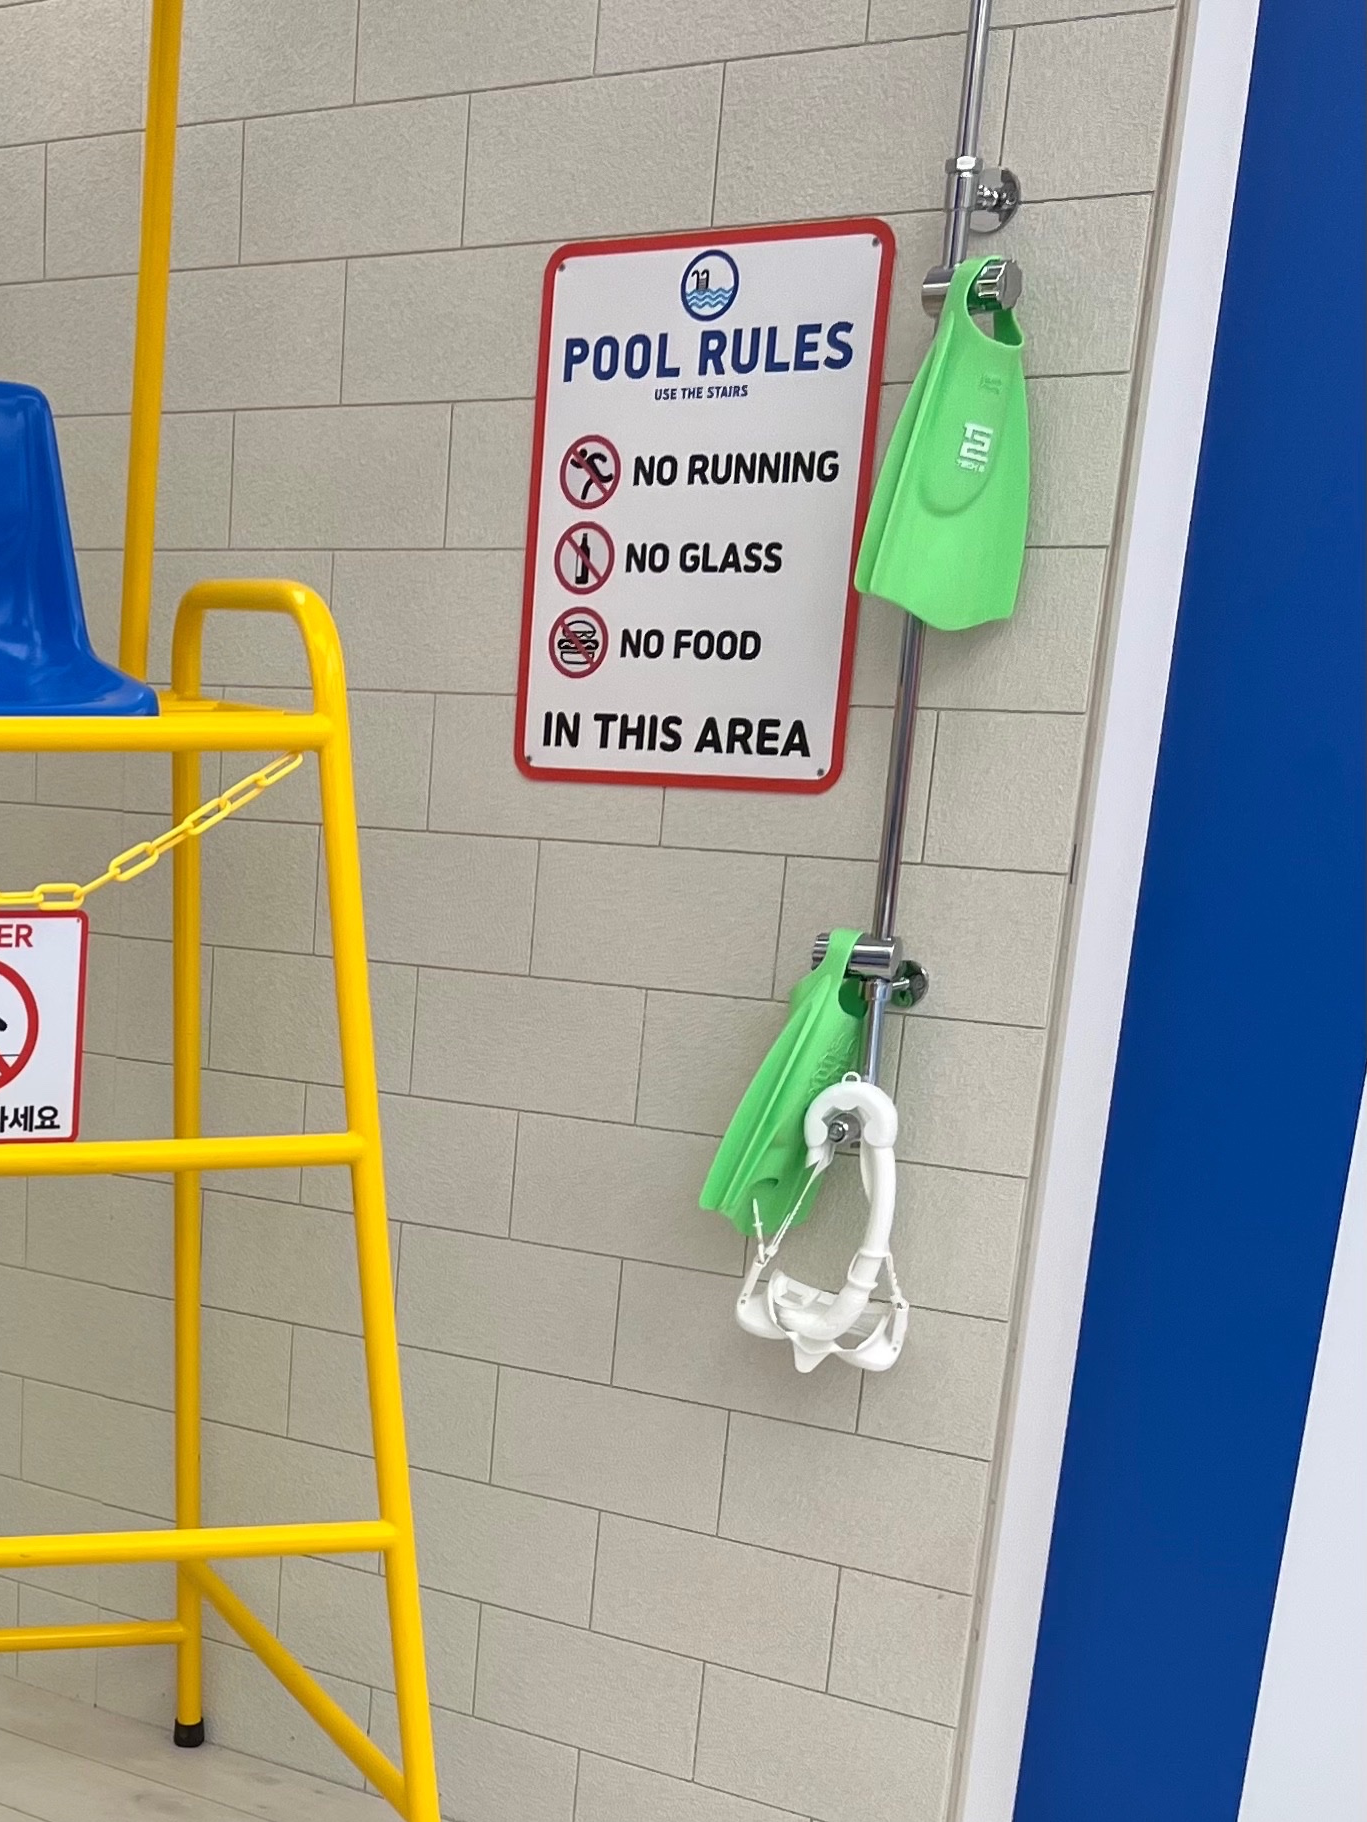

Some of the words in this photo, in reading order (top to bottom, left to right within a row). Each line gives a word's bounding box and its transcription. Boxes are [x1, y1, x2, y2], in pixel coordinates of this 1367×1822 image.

[564, 333, 680, 382] POOL
[698, 321, 854, 376] RULES
[655, 388, 677, 400] USE
[681, 387, 703, 399] THE
[707, 385, 748, 398] STAIRS
[633, 455, 677, 486] NO
[689, 451, 839, 485] RUNNING
[626, 543, 669, 573] NO
[680, 542, 782, 573] GLASS
[620, 629, 664, 658] NO
[674, 630, 761, 660] FOOD
[543, 712, 580, 747] IN
[594, 713, 682, 752] THIS
[694, 717, 810, 757] AREA
